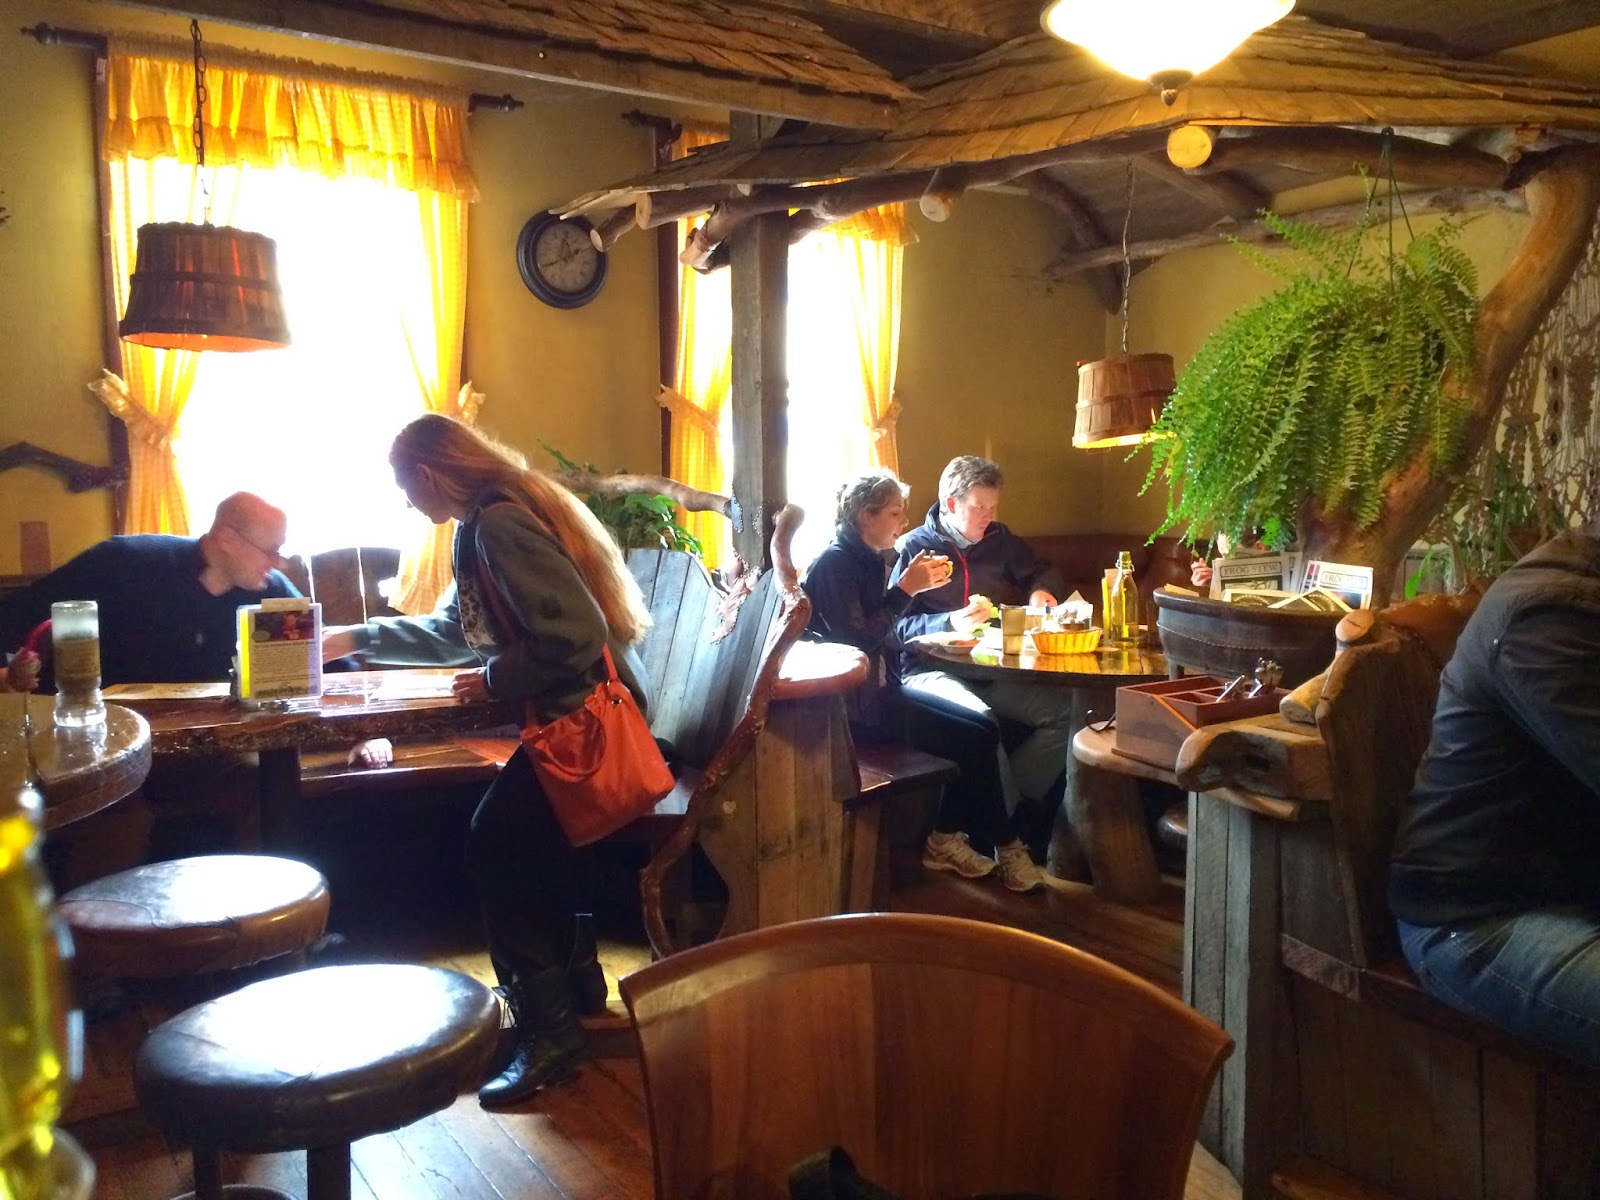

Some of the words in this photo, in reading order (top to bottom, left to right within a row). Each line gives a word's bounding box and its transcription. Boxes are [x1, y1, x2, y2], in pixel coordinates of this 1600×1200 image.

[1224, 566, 1249, 574] FROG
[1251, 564, 1279, 573] STEW
[1324, 573, 1344, 583] FRO
